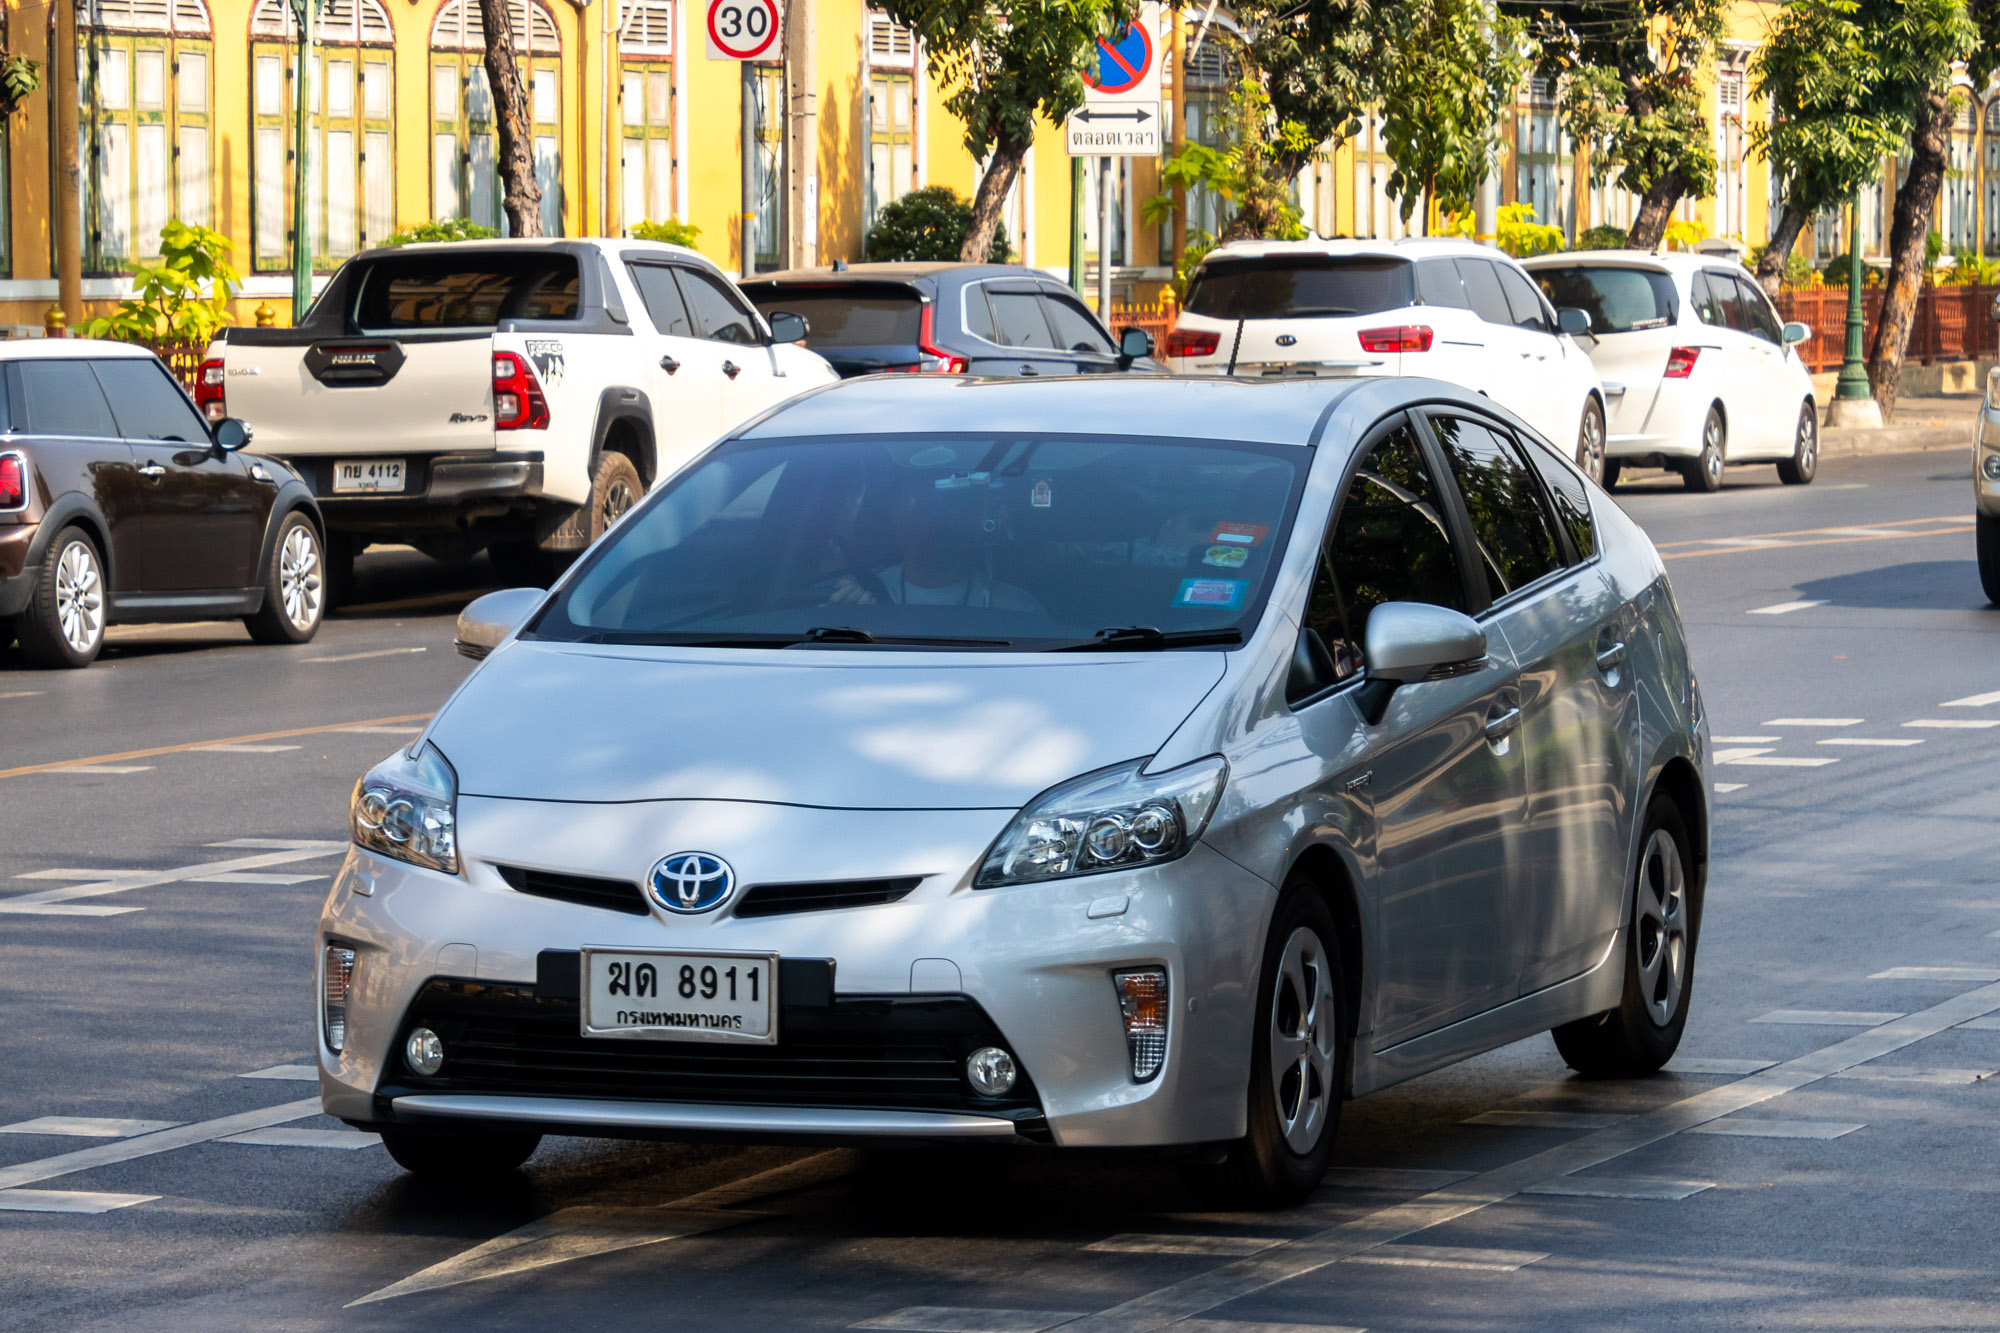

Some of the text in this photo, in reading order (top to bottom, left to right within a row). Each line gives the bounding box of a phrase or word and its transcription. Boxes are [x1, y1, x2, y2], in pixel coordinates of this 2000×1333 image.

[721, 6, 767, 37] 30
[1073, 131, 1154, 146] ตลอดเวลา
[529, 342, 564, 353] ROCCO
[368, 464, 400, 478] 4112
[678, 964, 760, 1002] 8911
[616, 1010, 743, 1029] กรงเทพมหานคร
